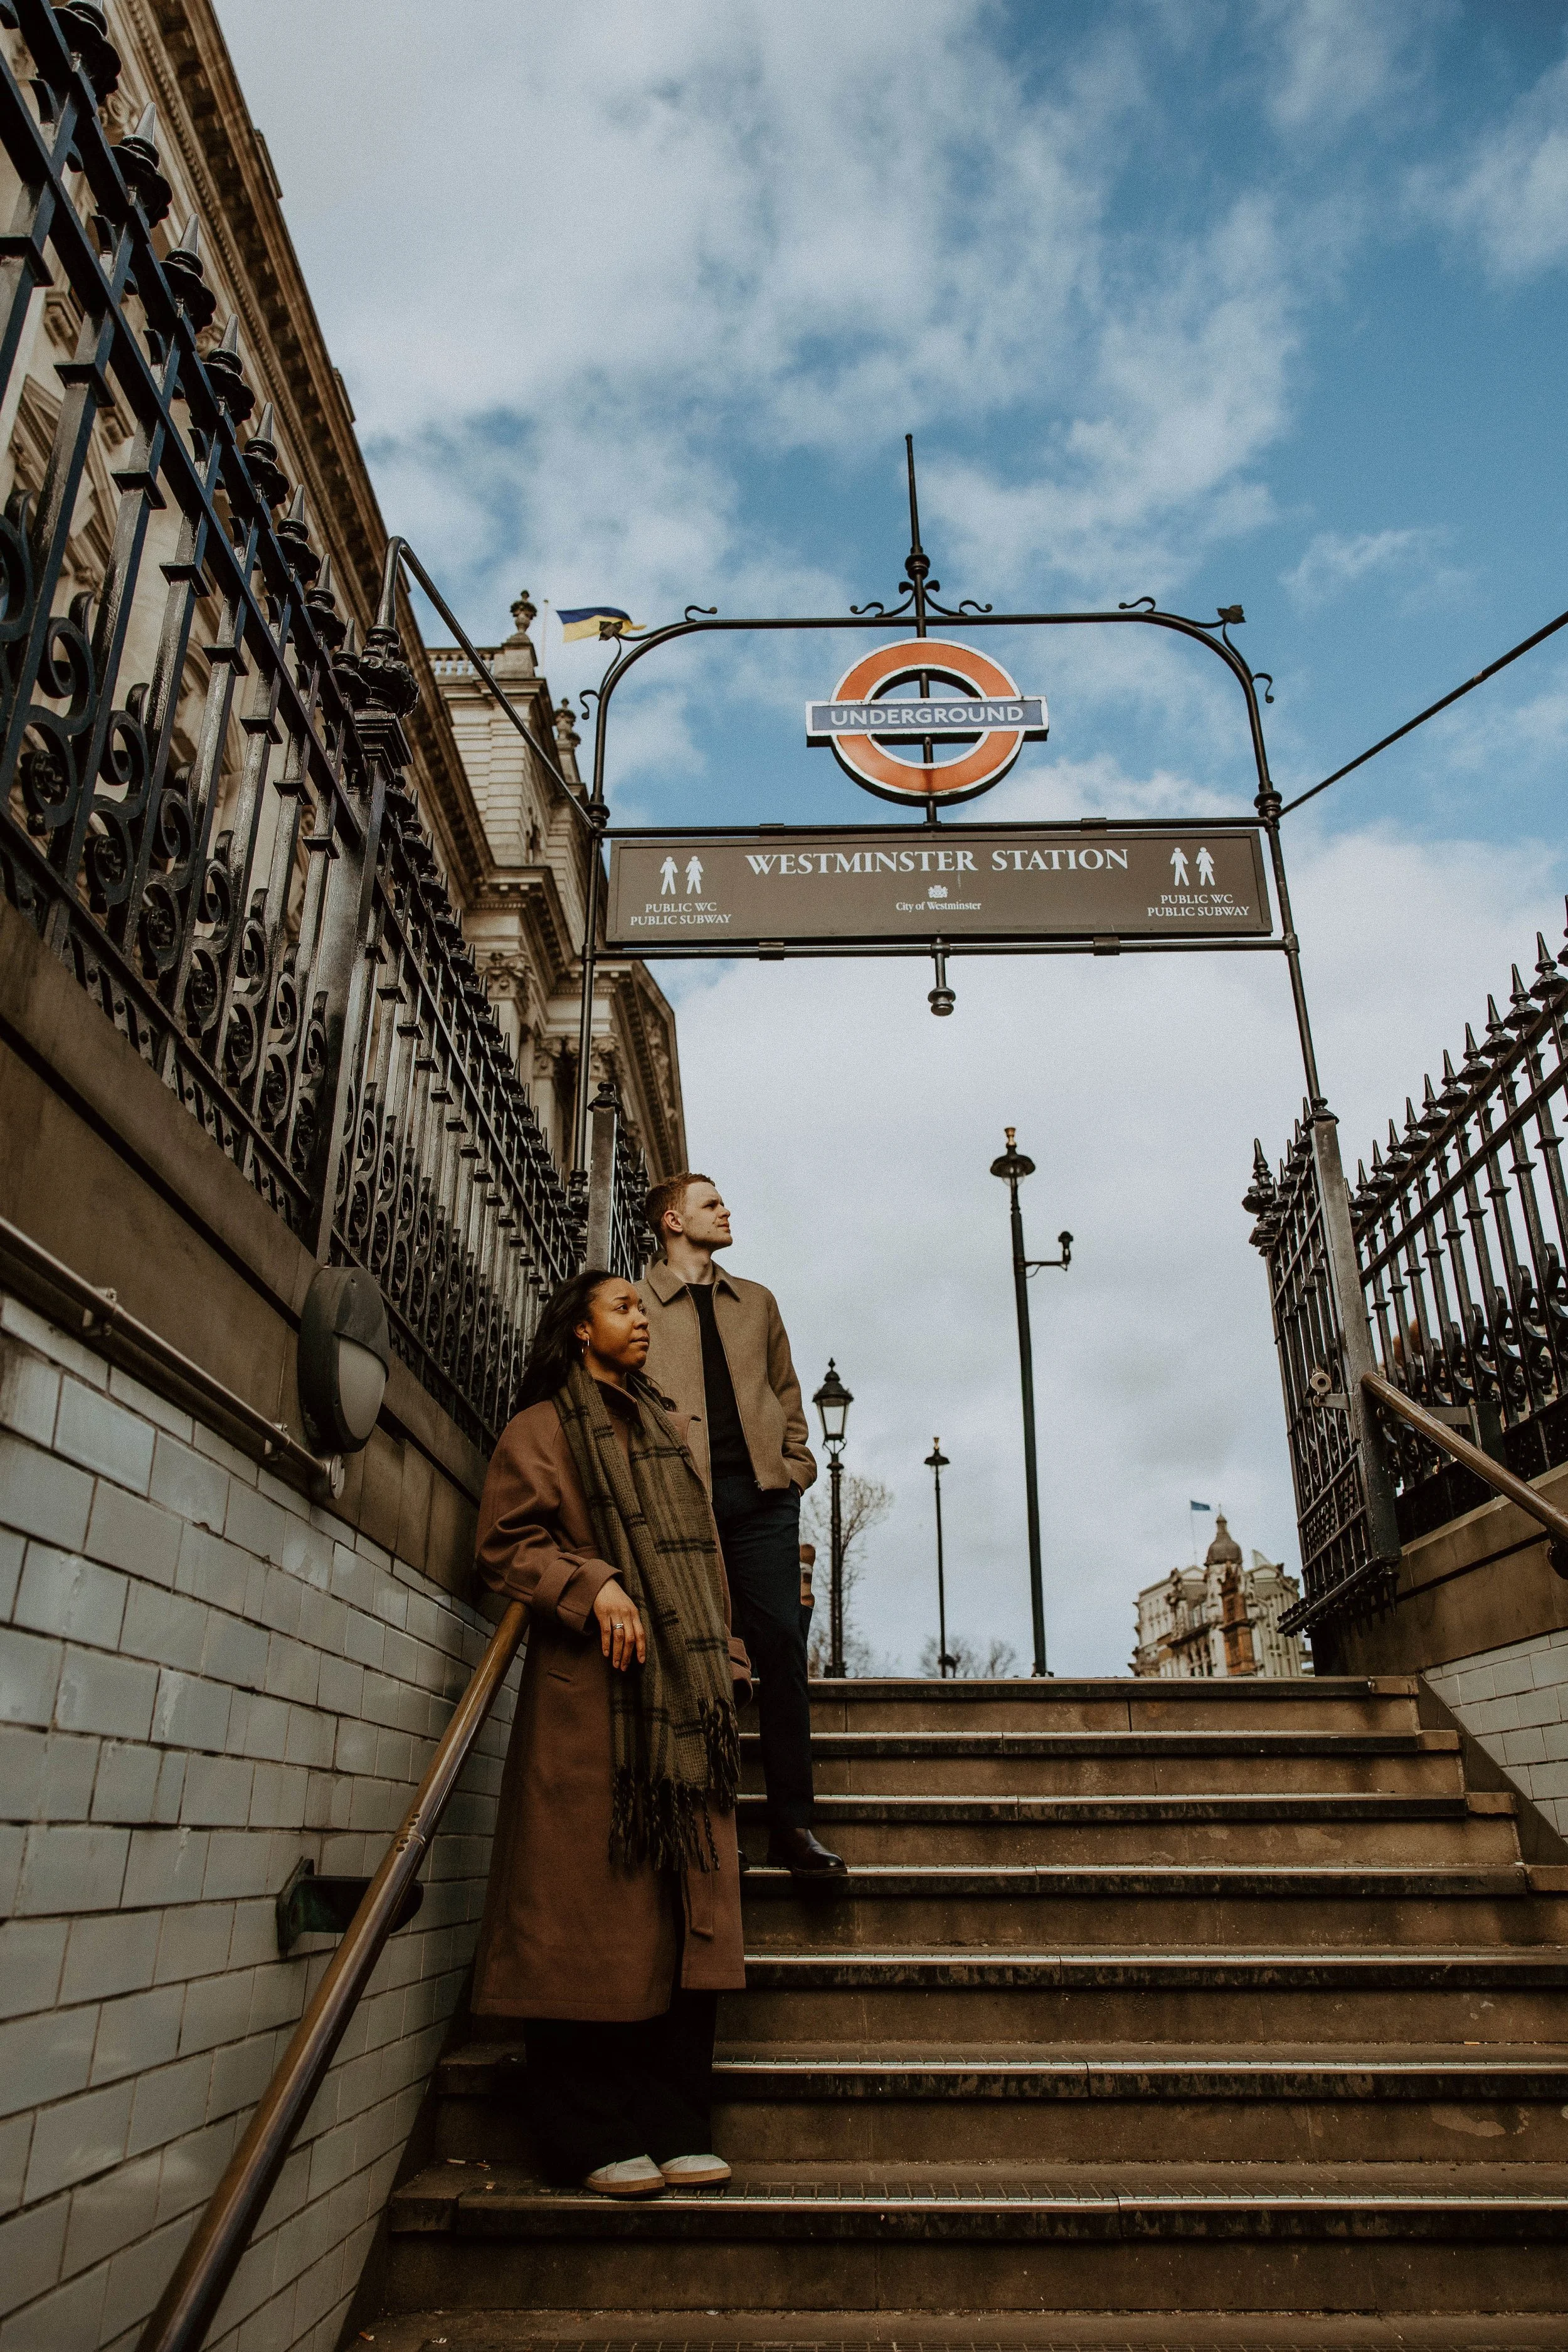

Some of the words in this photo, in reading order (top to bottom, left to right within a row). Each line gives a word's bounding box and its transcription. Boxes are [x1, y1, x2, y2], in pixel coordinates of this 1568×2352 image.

[830, 706, 1024, 726] UNDERGROUND
[744, 850, 978, 875] WESTMINSTER
[992, 849, 1128, 871] STATION
[1160, 894, 1209, 904] PUBLIC
[1210, 894, 1234, 904] WC
[645, 902, 692, 913] PUBLIC
[694, 901, 718, 912] WC
[895, 901, 914, 913] City
[914, 901, 925, 911] of
[926, 901, 982, 911] Westminster
[1147, 906, 1195, 917] PUBLIC
[1197, 906, 1249, 916] SUBWAY
[630, 914, 678, 926] PUBLIC
[679, 913, 733, 925] SUBWAY
